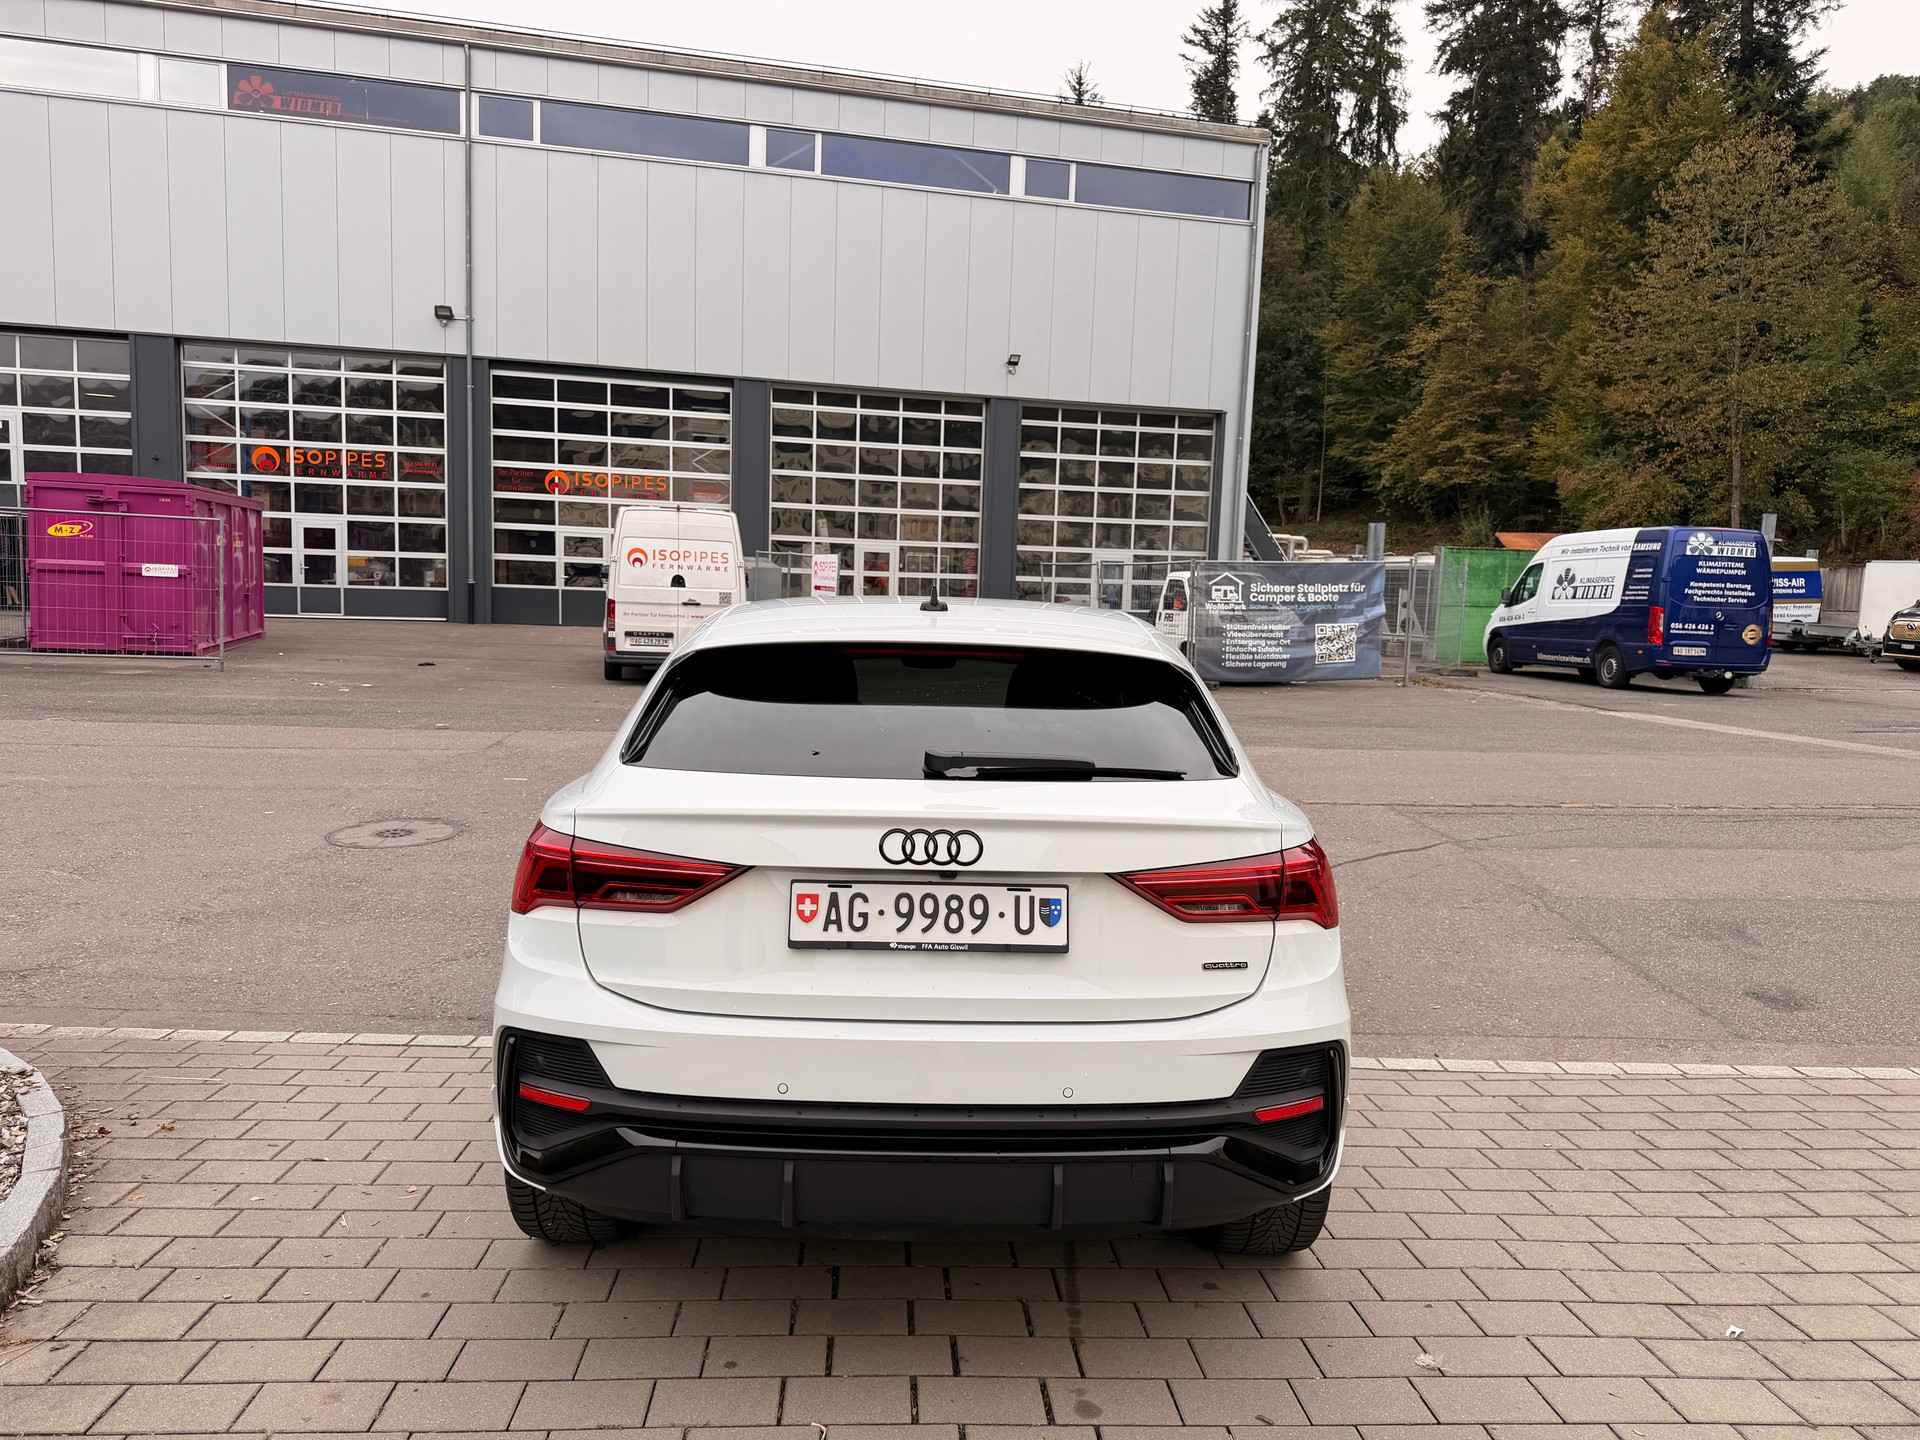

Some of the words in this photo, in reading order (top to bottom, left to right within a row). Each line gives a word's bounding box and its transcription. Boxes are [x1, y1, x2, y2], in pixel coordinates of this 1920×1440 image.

[280, 97, 339, 114] WIDMER
[285, 448, 386, 468] ISOPIPES
[575, 472, 667, 491] ISOPIPES
[497, 484, 535, 492] Fernwärme
[1633, 542, 1661, 551] SAMSUNG
[652, 549, 729, 564] ISOPIPES
[1717, 547, 1755, 557] WIDMER
[652, 563, 729, 573] FERNWÄRME
[1696, 568, 1746, 576] WÄRMEPUMPEN
[1579, 576, 1615, 584] KLIMASERVICE
[1690, 581, 1725, 589] Kompetente
[1250, 583, 1296, 593] Sicherer
[1297, 583, 1349, 595] Stellplatz
[1350, 583, 1366, 592] für
[1575, 585, 1613, 599] WIDMER
[1250, 593, 1295, 604] Camper
[1297, 593, 1306, 602] &
[1307, 593, 1339, 602] Boote
[1226, 639, 1266, 647] Entsorgung
[1253, 661, 1287, 669] Lagerung
